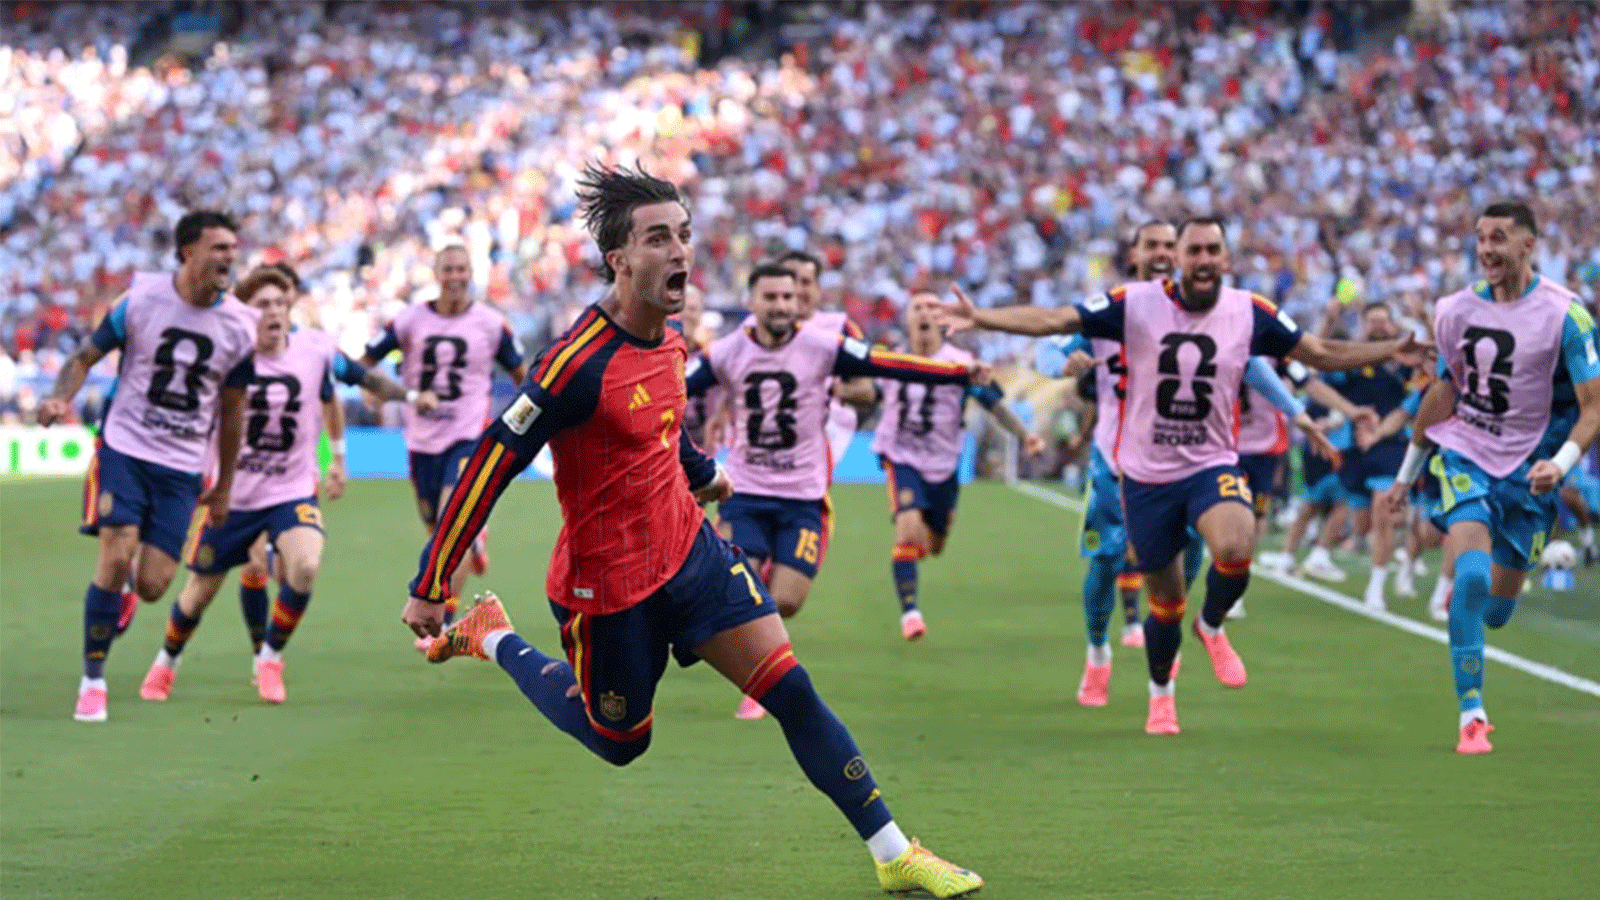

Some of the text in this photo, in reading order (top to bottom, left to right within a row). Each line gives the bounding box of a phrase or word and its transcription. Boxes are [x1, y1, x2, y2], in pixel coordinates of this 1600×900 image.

[660, 409, 675, 449] 7
[795, 528, 820, 564] 15
[730, 563, 763, 606] 7
